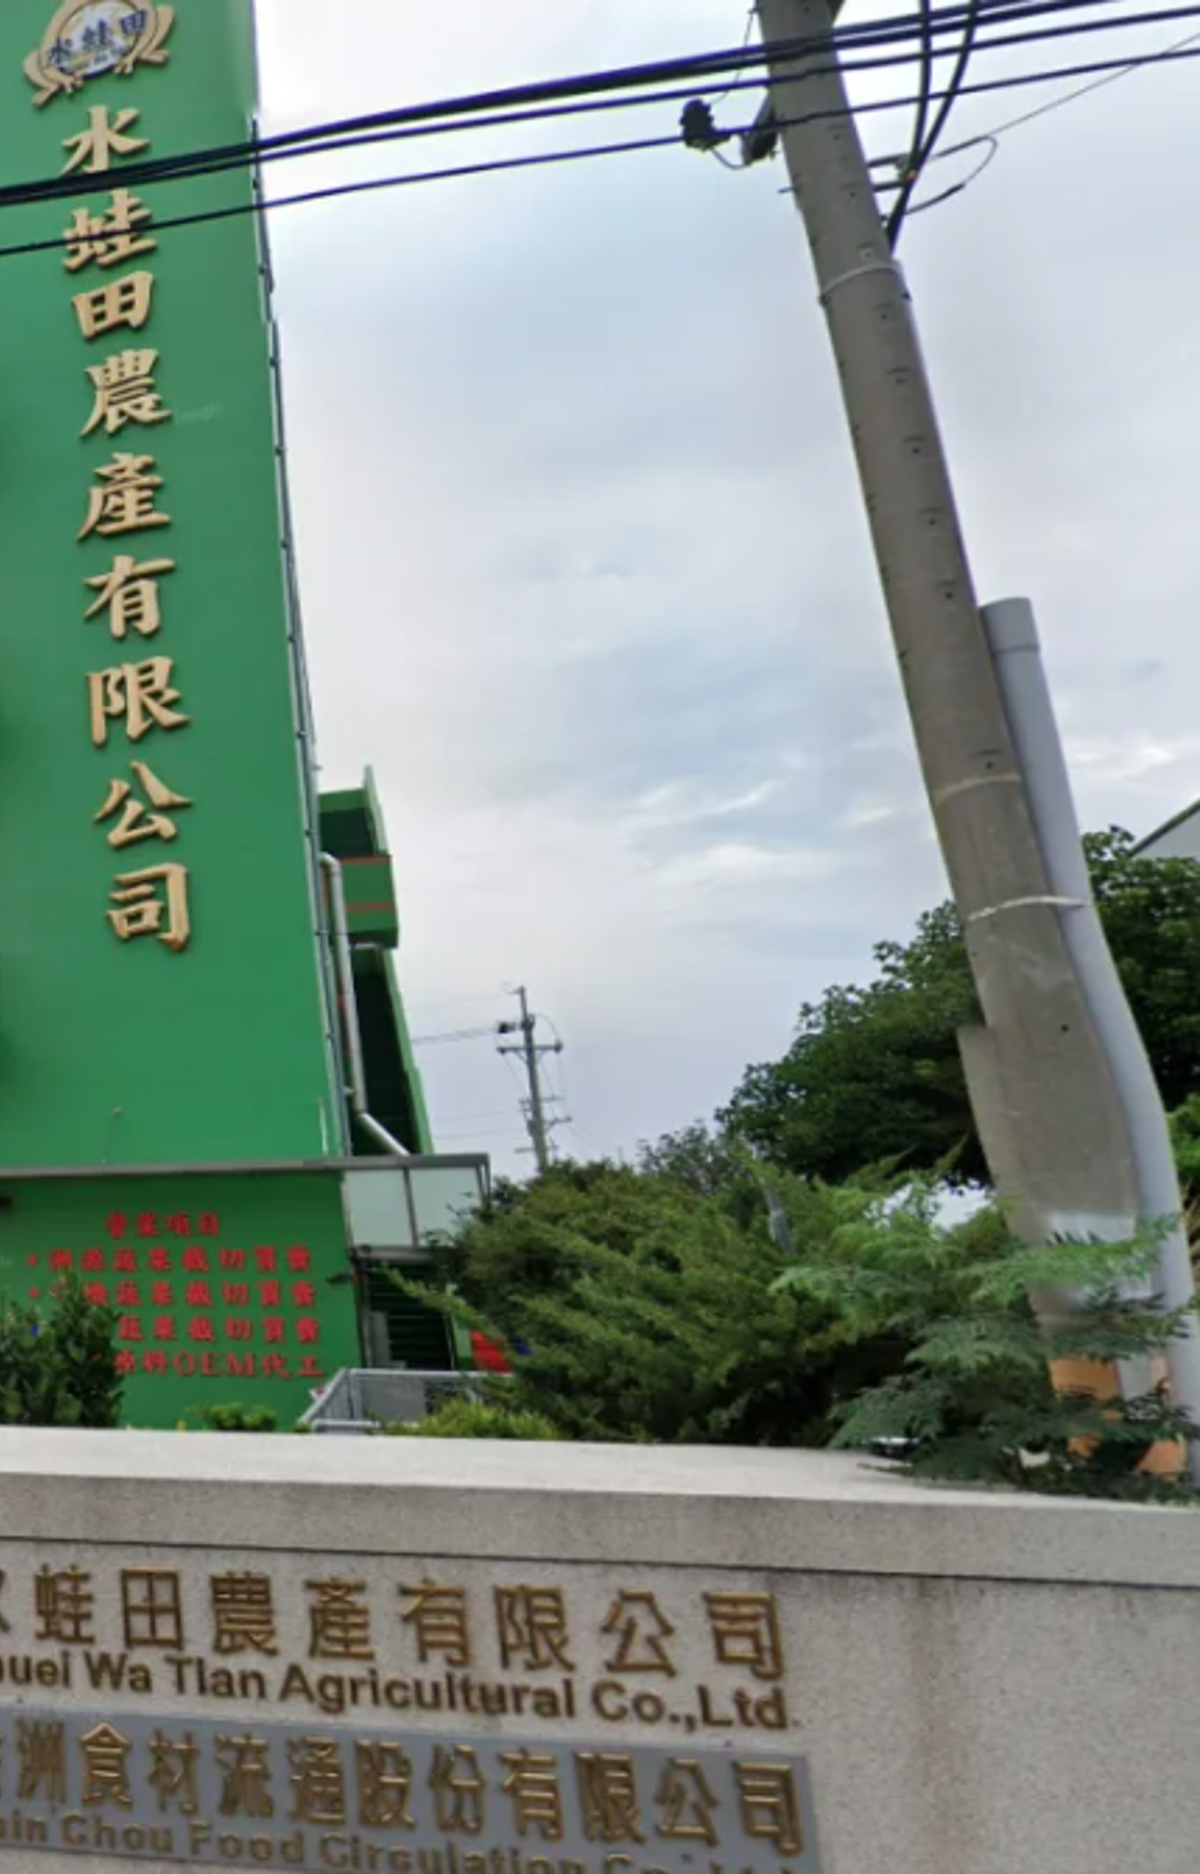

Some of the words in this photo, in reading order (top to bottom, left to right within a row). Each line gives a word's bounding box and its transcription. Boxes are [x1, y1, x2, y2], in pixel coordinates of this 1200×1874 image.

[61, 104, 191, 953] 水蛙田農產有限公司
[83, 1651, 153, 1693] Wa
[163, 1655, 266, 1699] Tian
[279, 1664, 576, 1719] Agricultural
[60, 1812, 173, 1856] Chou
[188, 1820, 306, 1866] Food
